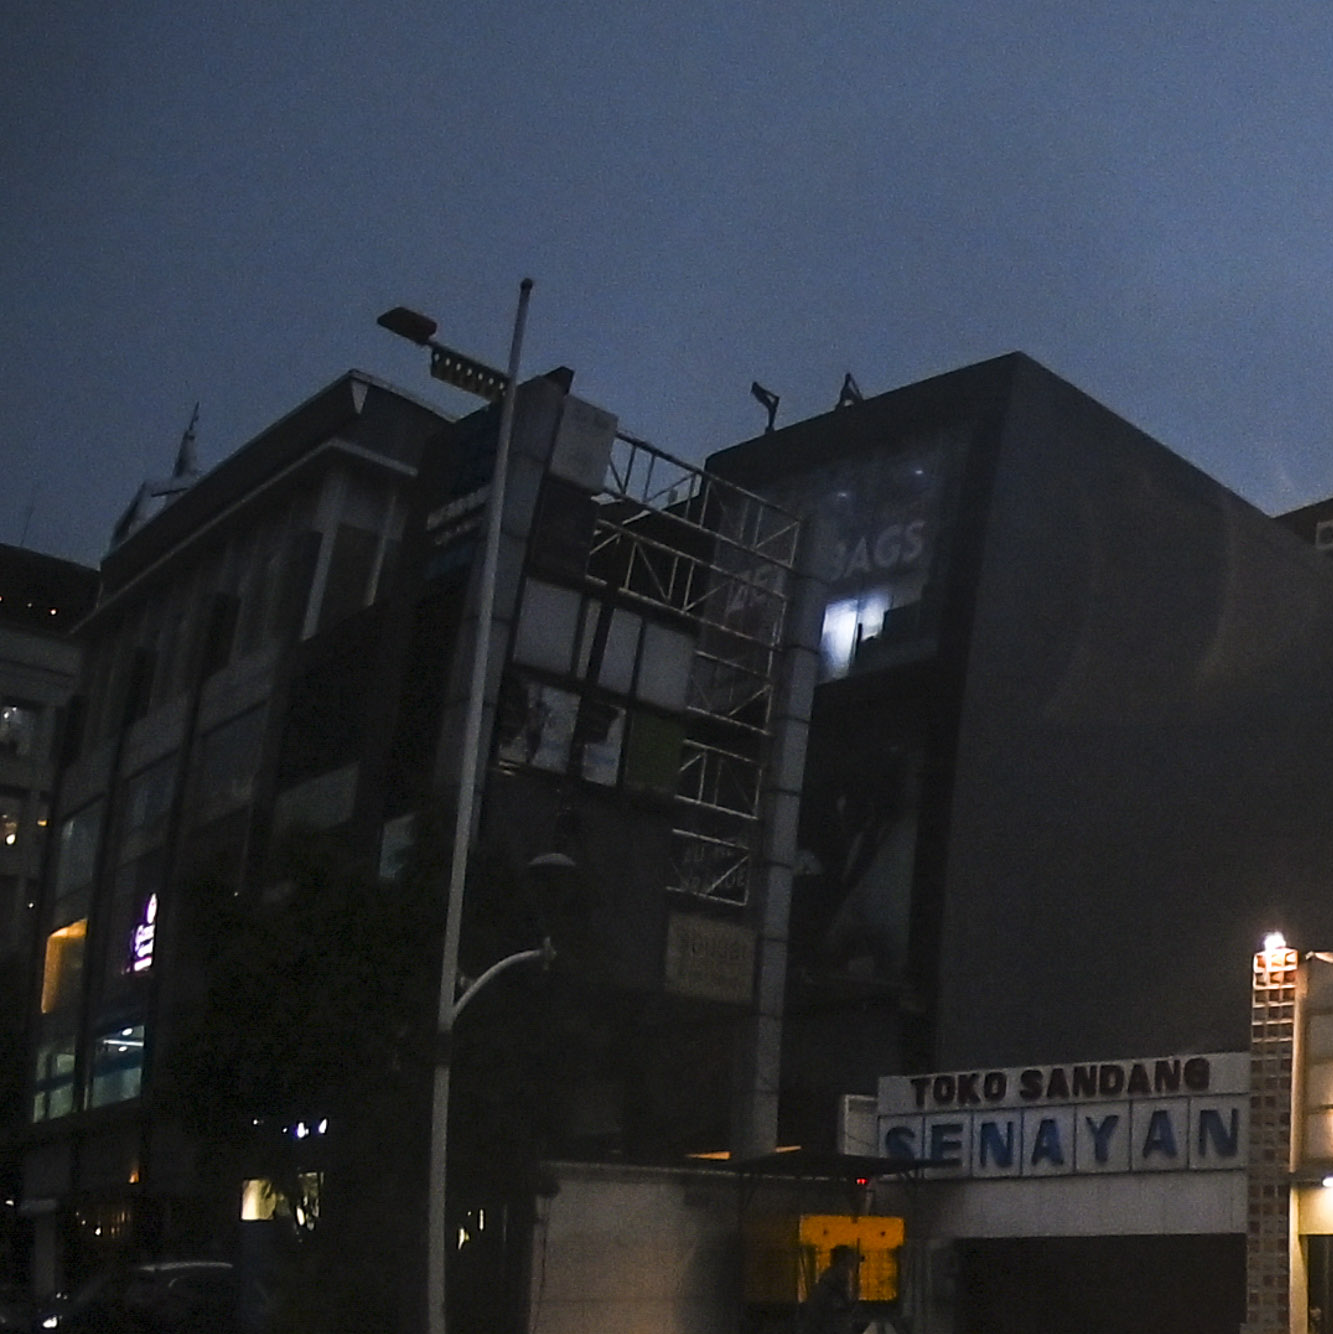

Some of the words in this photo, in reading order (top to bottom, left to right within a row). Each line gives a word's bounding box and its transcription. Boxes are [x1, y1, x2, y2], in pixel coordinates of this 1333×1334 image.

[909, 1070, 1007, 1107] TOKO
[1019, 1056, 1210, 1101] SANDANG
[885, 1107, 1239, 1168] SENAYAN
